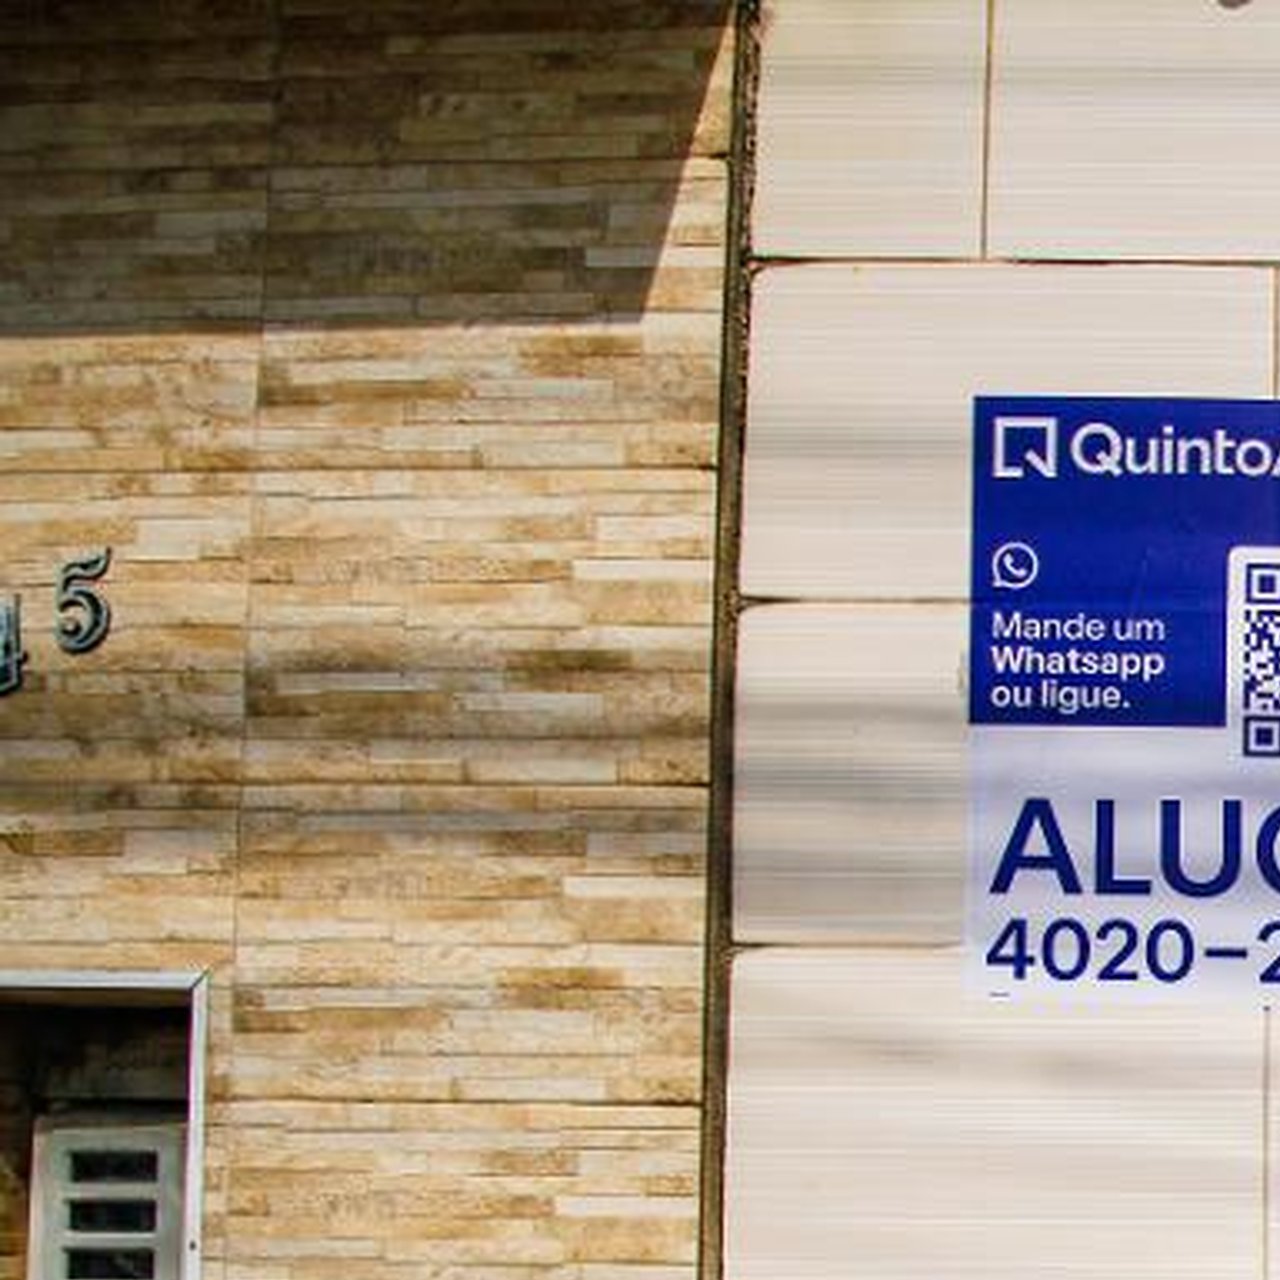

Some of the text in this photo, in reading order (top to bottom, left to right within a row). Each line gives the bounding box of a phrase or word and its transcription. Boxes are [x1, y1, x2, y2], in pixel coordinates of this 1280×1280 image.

[992, 611, 1165, 640] Mande um
[990, 645, 1166, 682] Whatsapp
[991, 679, 1131, 714] ou ligue.
